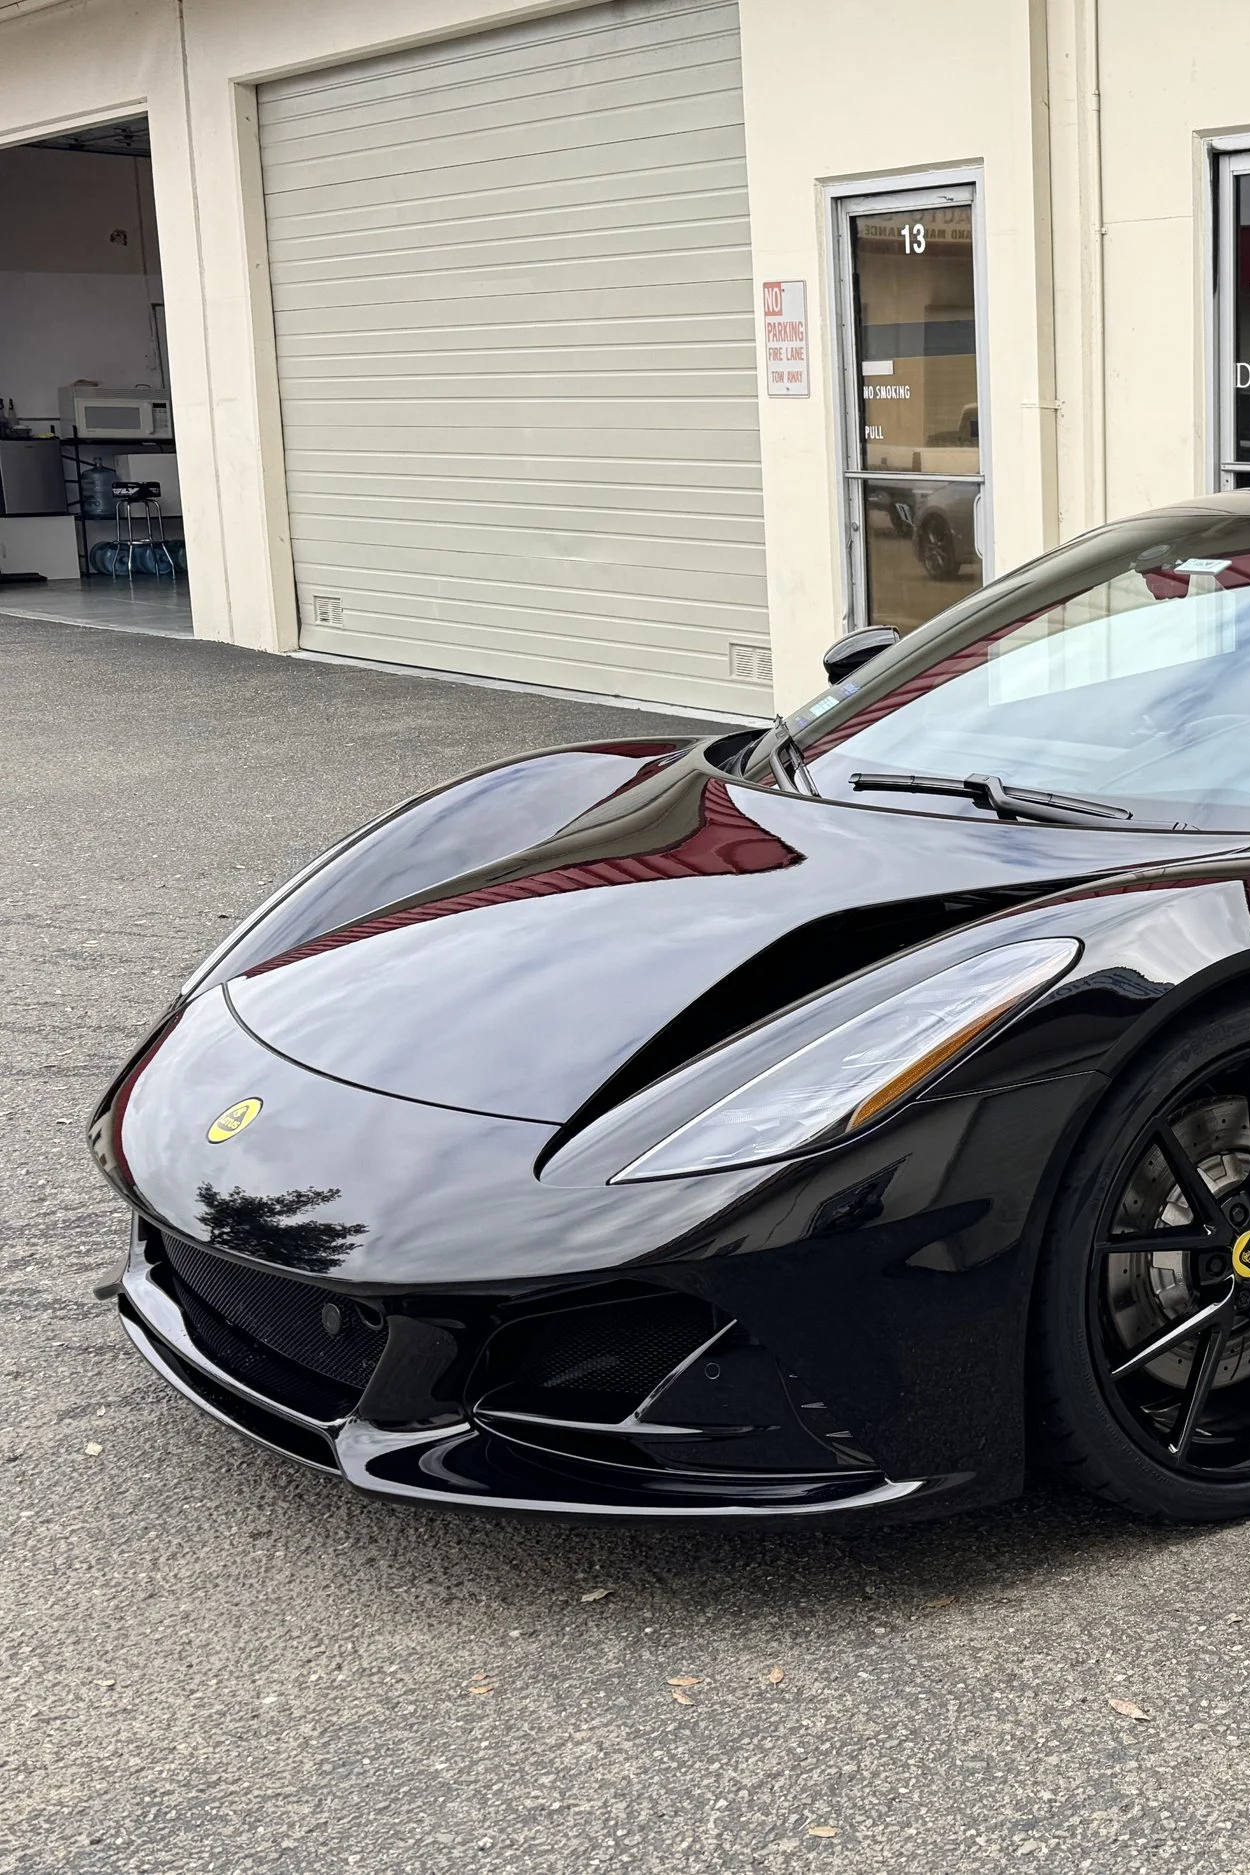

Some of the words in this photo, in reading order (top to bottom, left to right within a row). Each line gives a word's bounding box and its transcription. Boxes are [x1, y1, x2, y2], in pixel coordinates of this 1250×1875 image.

[901, 224, 926, 254] 13
[764, 287, 781, 313] NO
[767, 321, 804, 342] PARKING
[768, 347, 783, 361] FIRE
[786, 346, 804, 361] LANE
[771, 370, 785, 384] TOW
[787, 370, 803, 384] AWAY
[863, 385, 874, 399] NO
[875, 385, 911, 399] SMOKING
[864, 425, 884, 440] PULL
